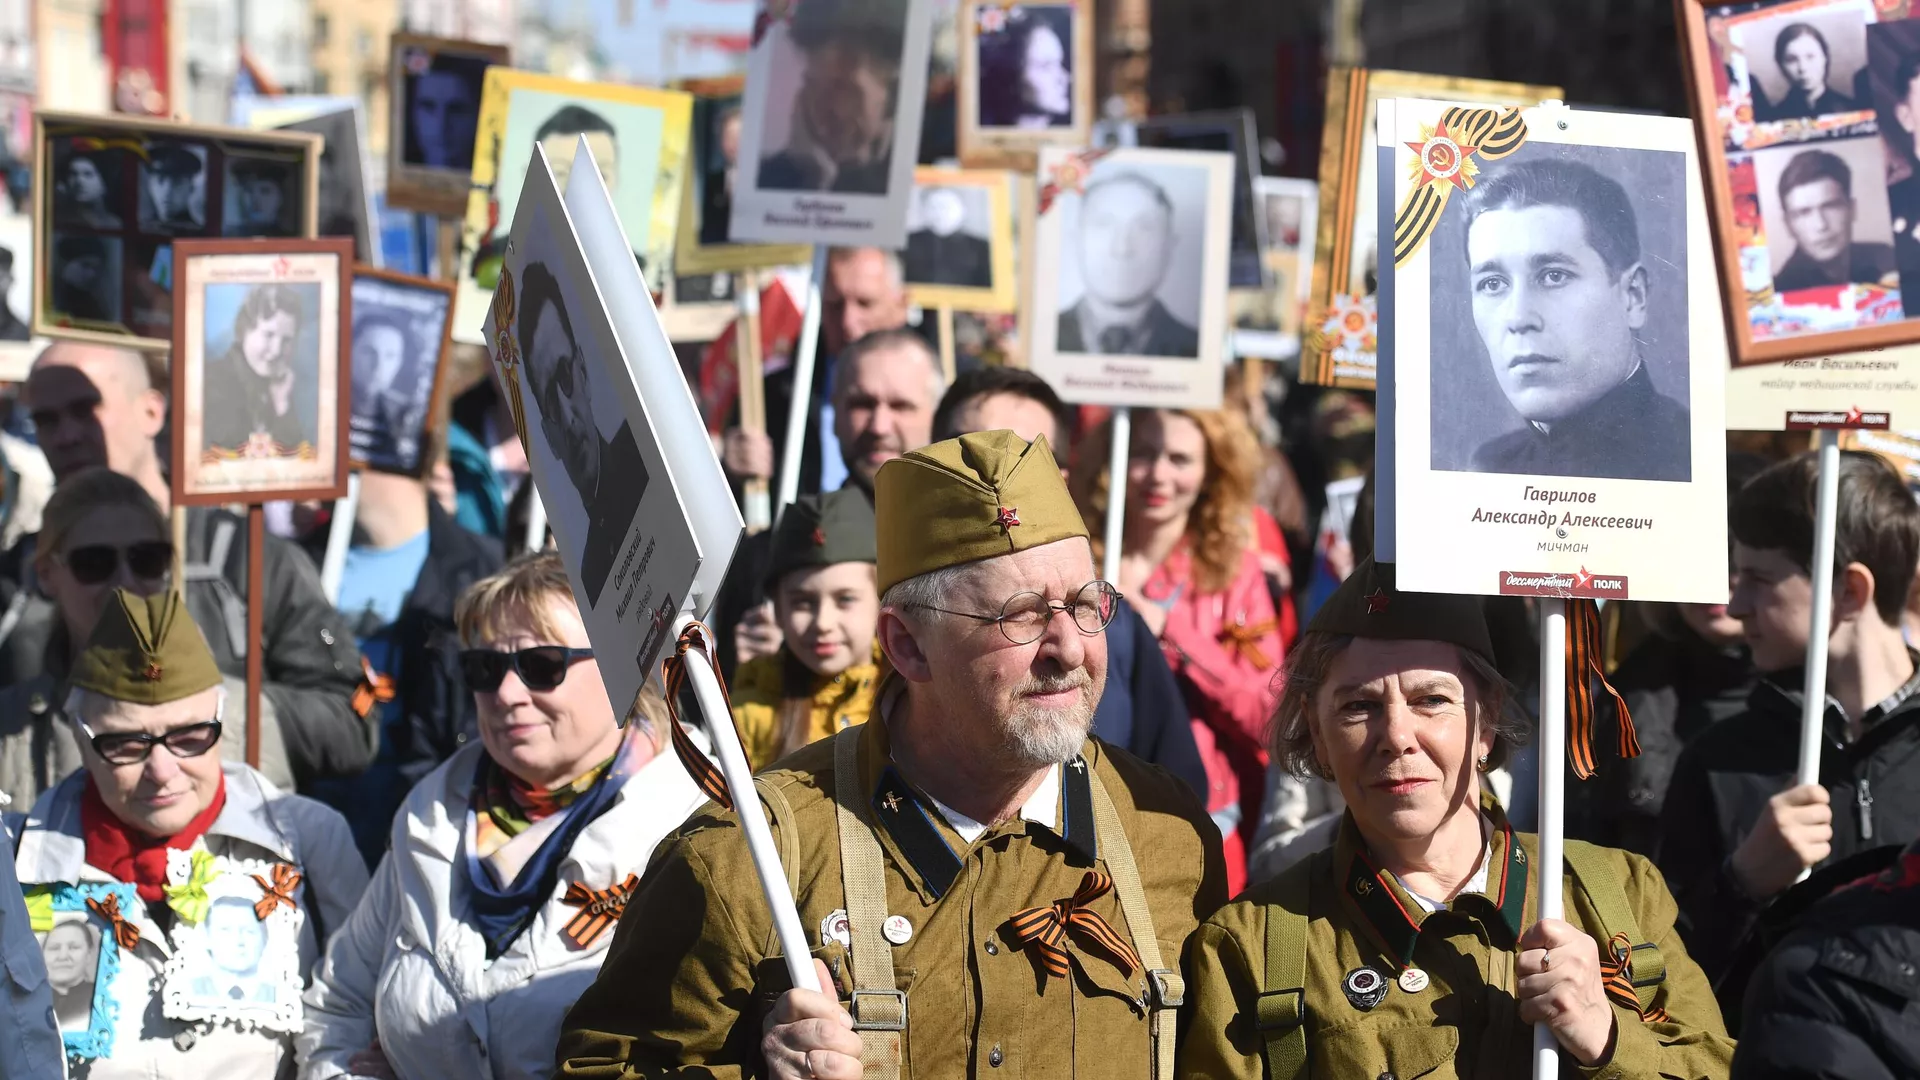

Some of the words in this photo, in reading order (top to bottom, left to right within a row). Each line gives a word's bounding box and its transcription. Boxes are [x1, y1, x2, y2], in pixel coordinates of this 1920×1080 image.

[1820, 358, 1899, 371] Васильевич
[1523, 485, 1597, 505] Гаврилов
[1471, 507, 1557, 529] Александр
[1560, 511, 1653, 530] Алексеевич
[1536, 541, 1589, 553] мичман
[613, 526, 642, 591] Соколовский
[615, 583, 635, 624] Михаил
[631, 536, 657, 590] Петрович
[1593, 579, 1623, 590] ПОЛК
